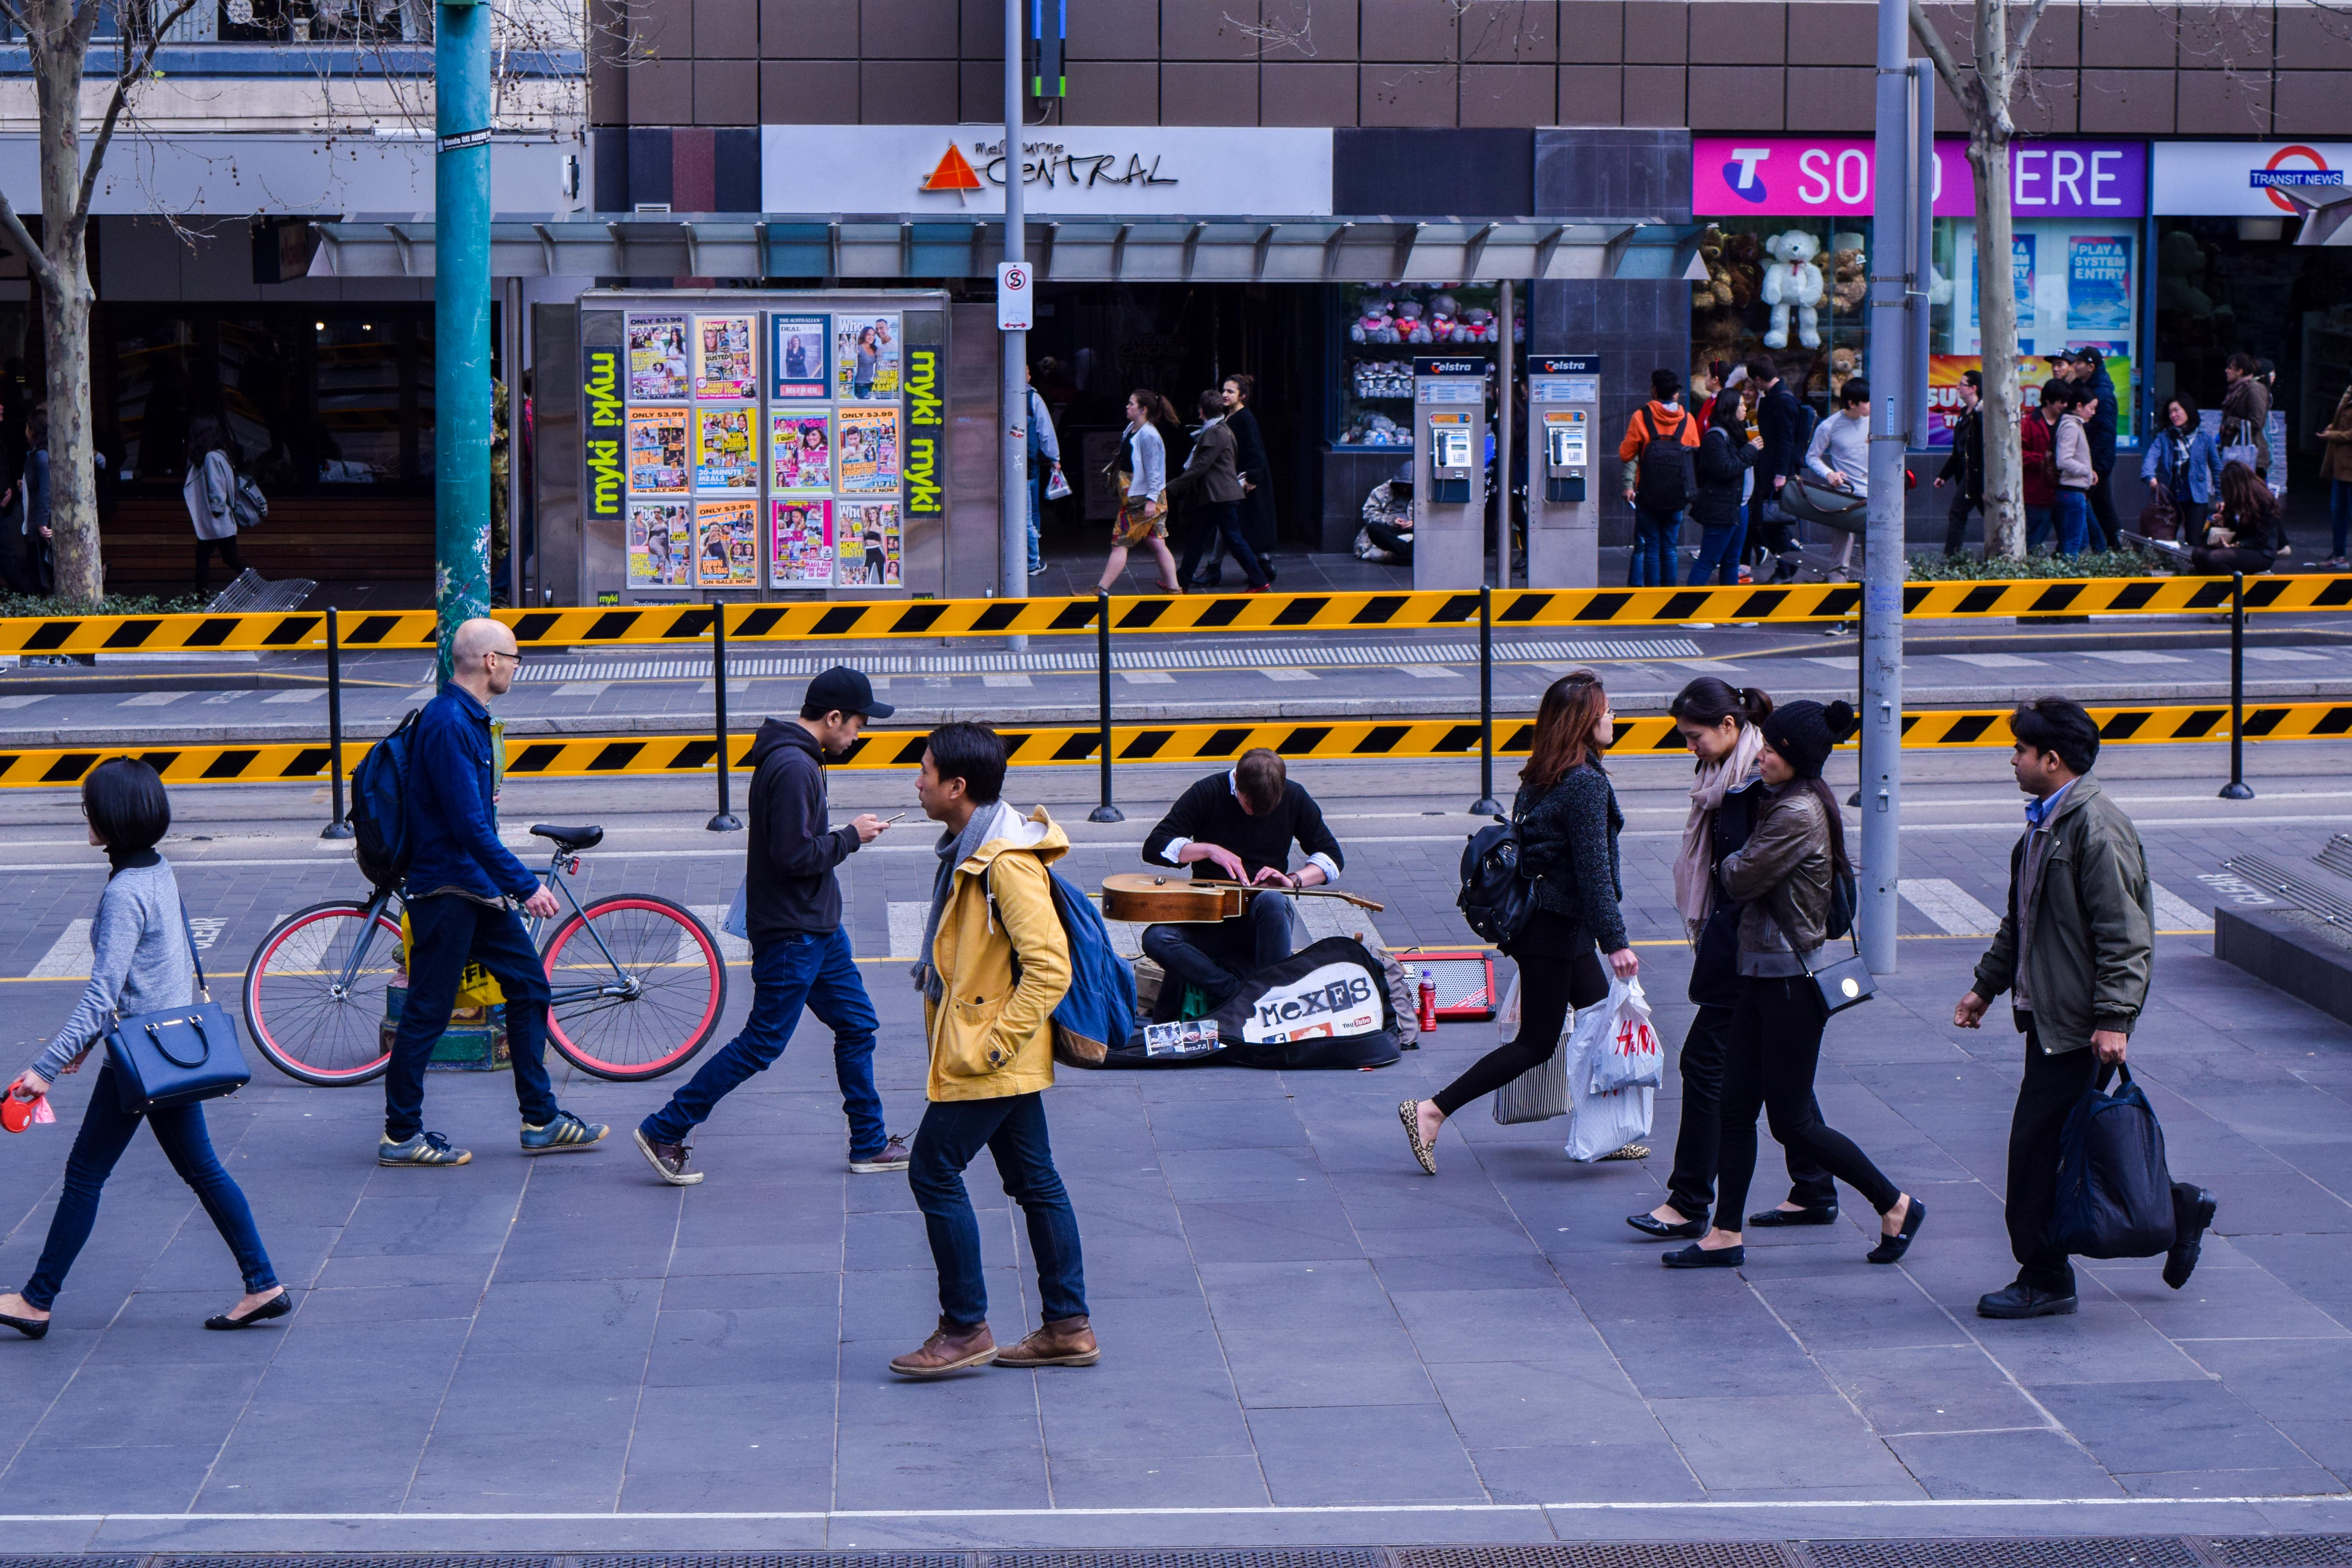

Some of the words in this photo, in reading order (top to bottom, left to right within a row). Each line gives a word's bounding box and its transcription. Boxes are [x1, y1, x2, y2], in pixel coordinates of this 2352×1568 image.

[2015, 151, 2122, 205] ERE
[2252, 173, 2303, 184] TRANSIT
[2305, 173, 2342, 185] NEWS
[2079, 244, 2111, 255] PLAY
[2113, 243, 2123, 255] A
[2075, 256, 2125, 266] SYSTEM
[2075, 268, 2125, 279] ENTRY
[840, 319, 863, 333] Who
[1432, 362, 1471, 371] Telstra
[1545, 361, 1585, 370] Telstra
[584, 353, 622, 426] myki
[904, 352, 942, 425] myki
[587, 441, 625, 513] myki
[903, 439, 941, 512] myki
[840, 549, 853, 557] DID
[599, 594, 618, 604] myki
[1615, 1020, 1655, 1058] H&M
